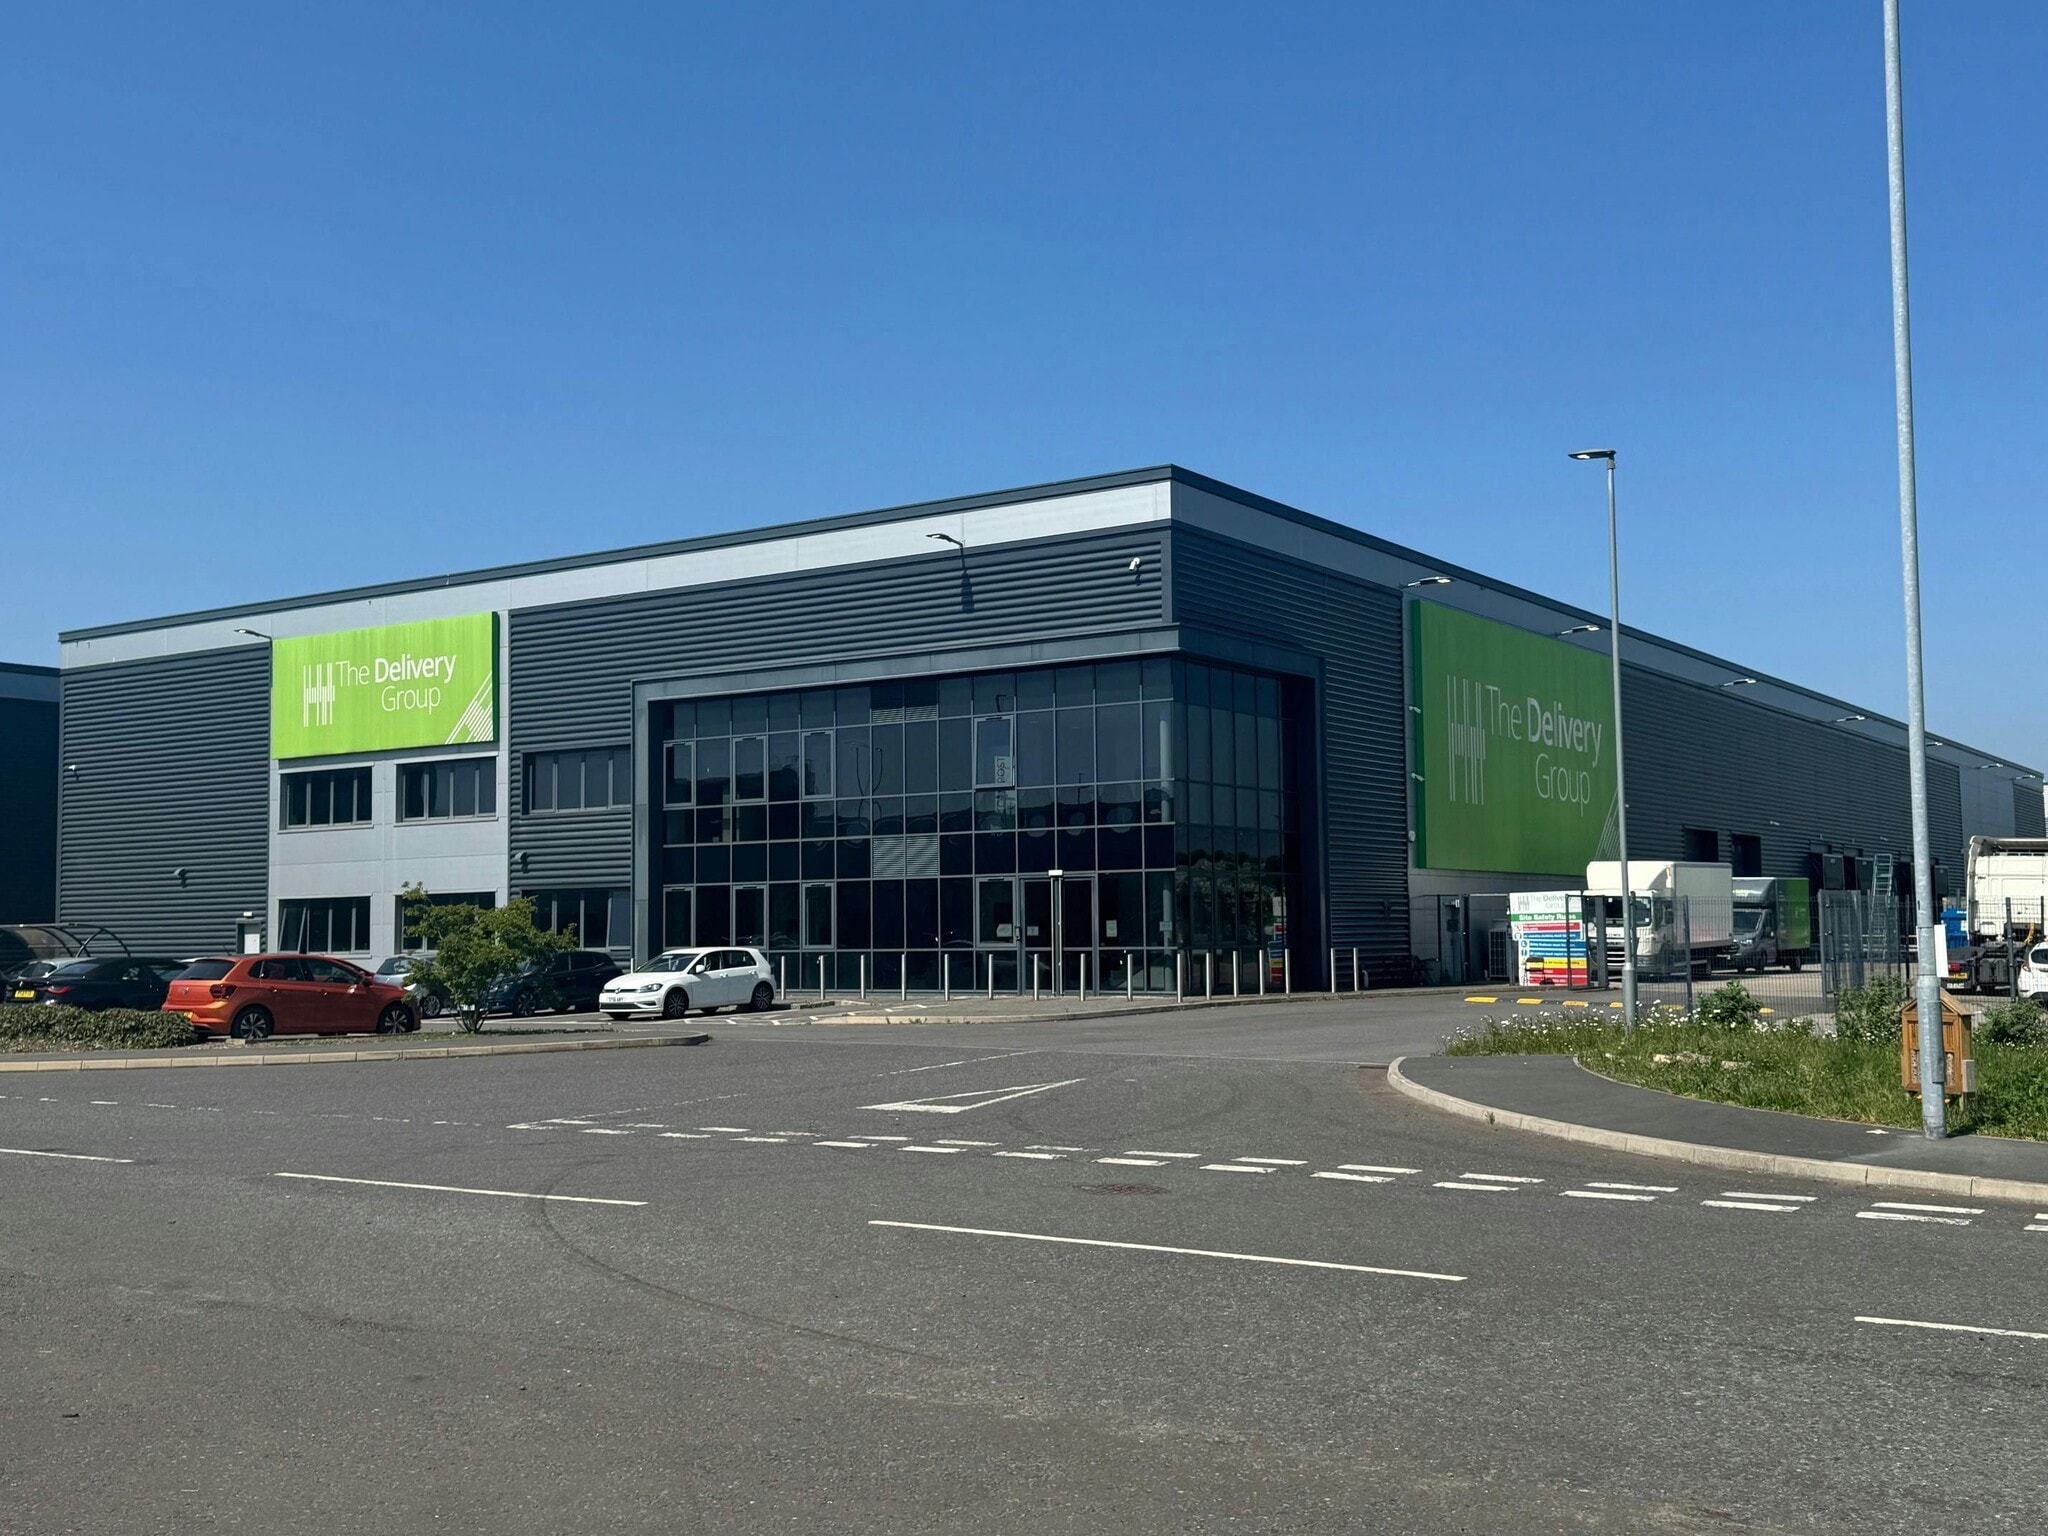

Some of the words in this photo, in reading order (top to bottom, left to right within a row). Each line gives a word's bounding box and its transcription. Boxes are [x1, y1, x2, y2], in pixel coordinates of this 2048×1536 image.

[336, 660, 370, 688] The
[374, 653, 457, 684] Delivery
[381, 685, 441, 715] Group
[1485, 684, 1522, 740] The
[1527, 696, 1602, 768] Delivery
[1535, 753, 1591, 817] Group
[1543, 894, 1572, 902] Delivey
